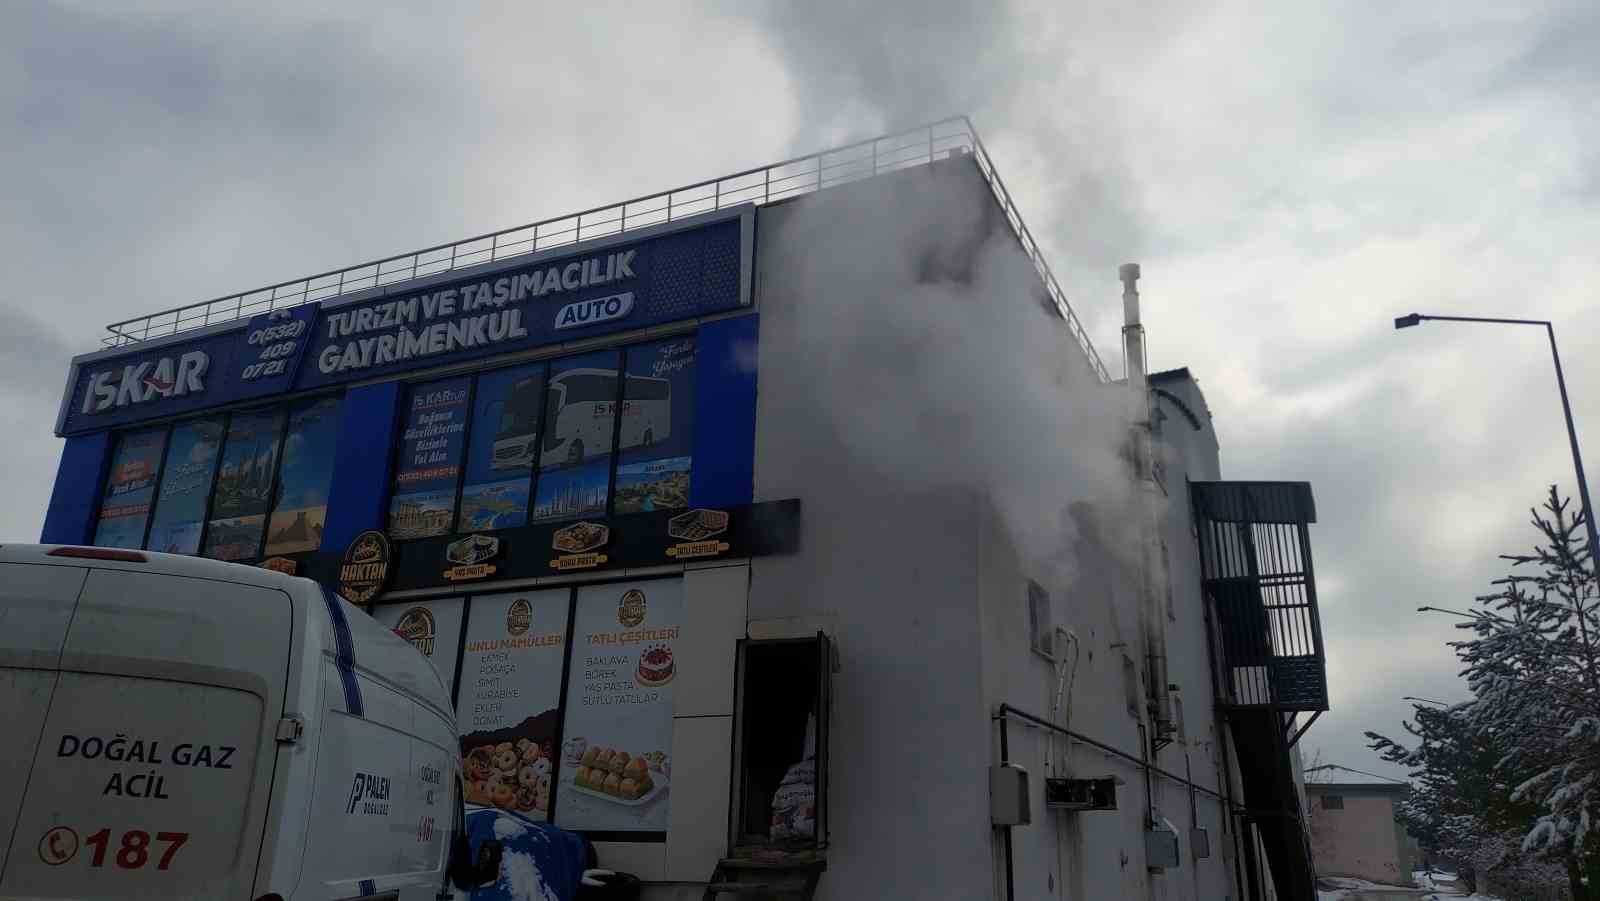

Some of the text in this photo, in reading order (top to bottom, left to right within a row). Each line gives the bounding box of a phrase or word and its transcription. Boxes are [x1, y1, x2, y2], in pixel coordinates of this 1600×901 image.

[421, 289, 457, 319] VE
[460, 249, 638, 311] TAŞIMACILIK
[562, 297, 621, 325] AUTO
[259, 341, 296, 360] 409
[319, 309, 528, 374] GAYRİMENKUL
[340, 562, 387, 581] HAKTAN
[57, 733, 236, 769] DOĞAL GAZ
[103, 770, 168, 799] ACİL
[365, 774, 390, 801] PALEN
[86, 828, 189, 870] 187
